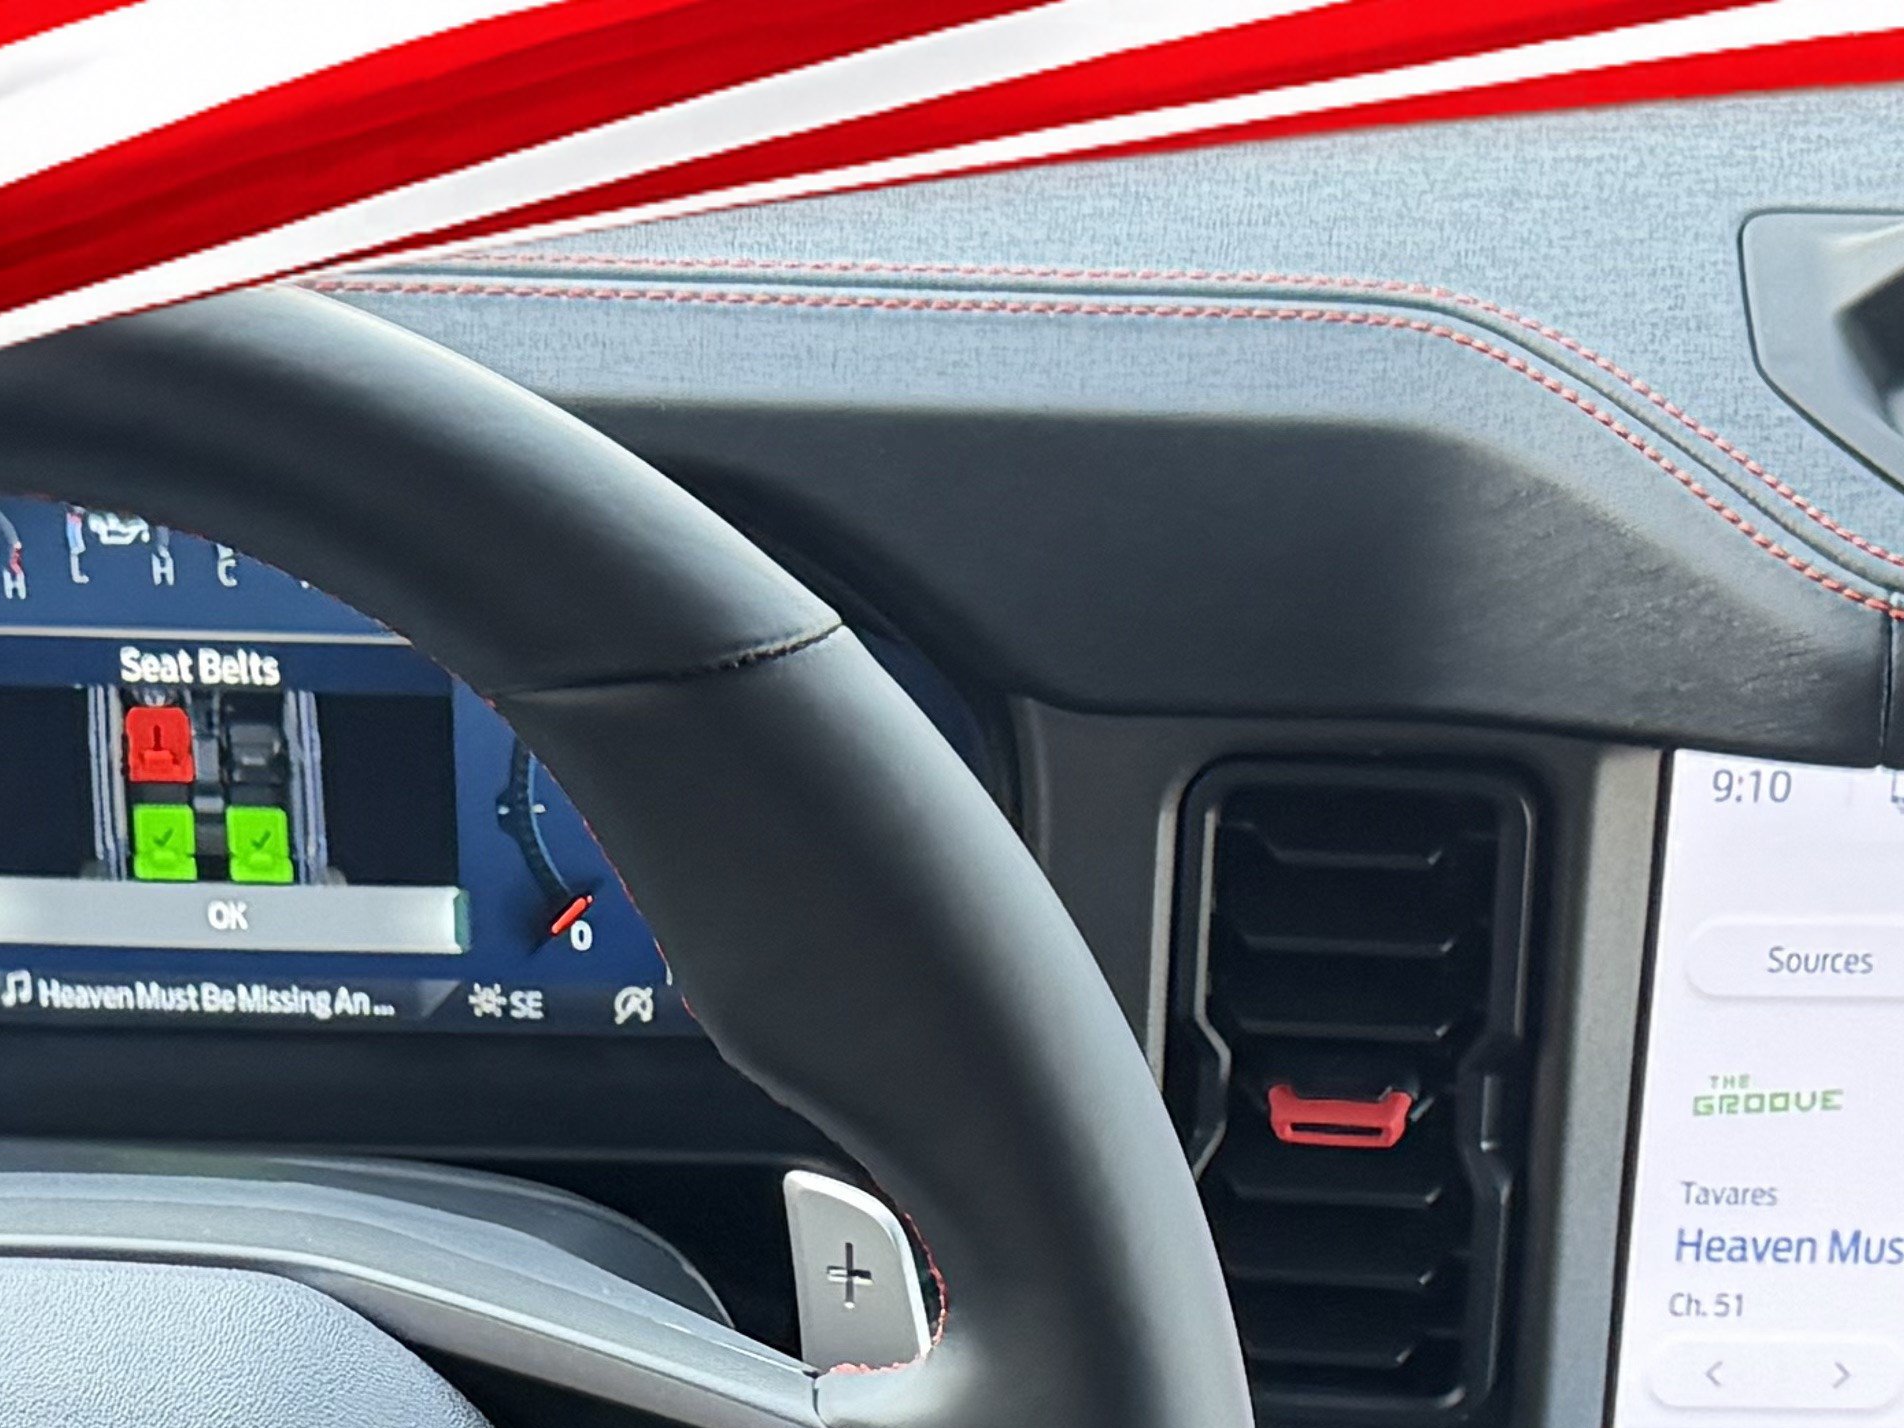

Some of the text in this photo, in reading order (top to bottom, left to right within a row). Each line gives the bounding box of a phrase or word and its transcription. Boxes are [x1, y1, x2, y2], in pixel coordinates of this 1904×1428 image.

[119, 645, 281, 687] Seat Belts
[1710, 768, 1793, 804] 9:10
[206, 901, 248, 930] OK
[569, 920, 593, 951] 0
[1767, 945, 1874, 977] Sources
[37, 978, 133, 1011] Heaven
[136, 981, 200, 1013] Must
[202, 983, 234, 1014] Be
[236, 984, 332, 1021] Missing
[1709, 1074, 1751, 1089] THE
[1692, 1088, 1844, 1117] GROOVE
[1681, 1180, 1779, 1209] Tavares
[1675, 1227, 1818, 1267] Heaven
[1668, 1291, 1745, 1320] Ch. 51
